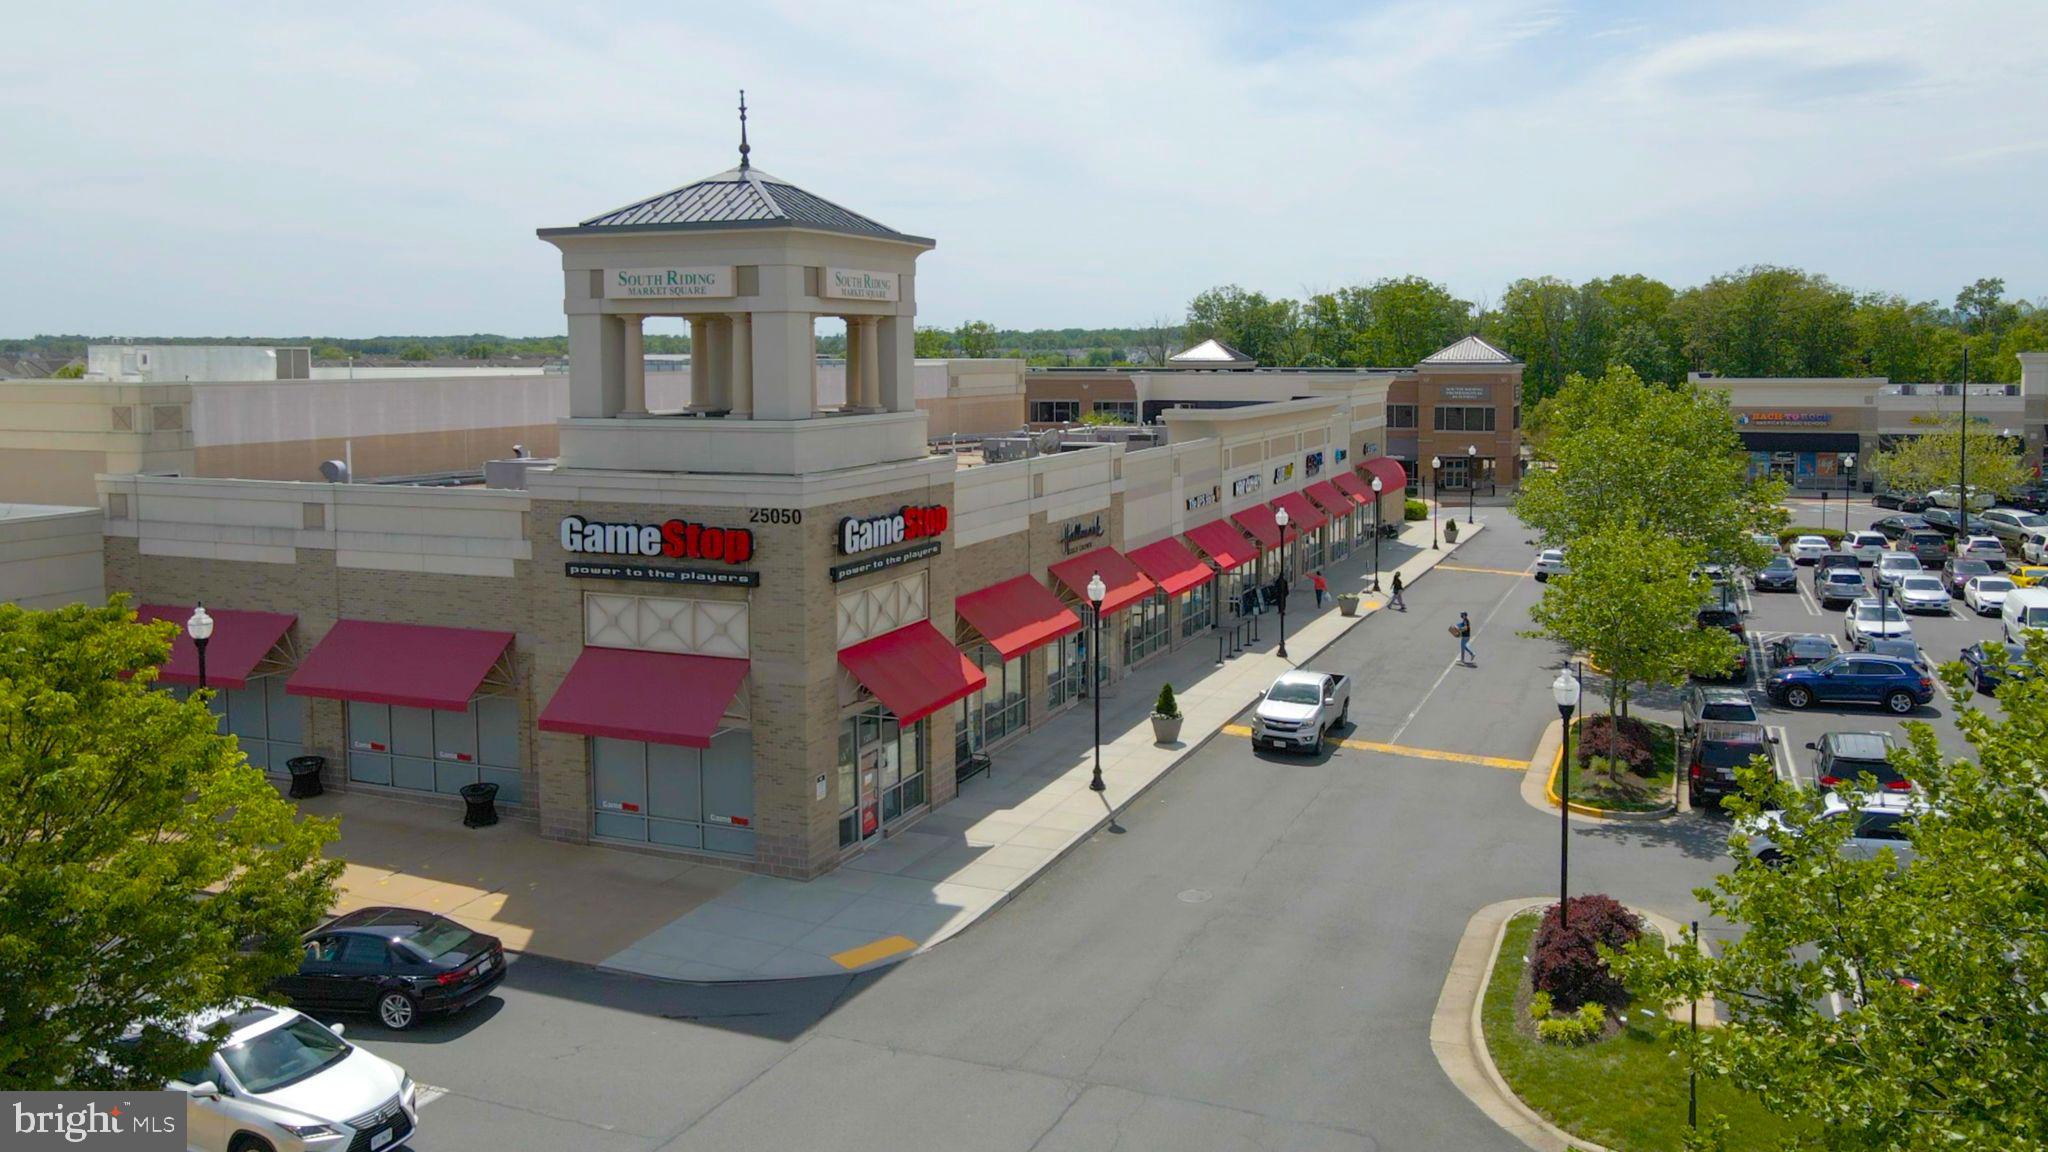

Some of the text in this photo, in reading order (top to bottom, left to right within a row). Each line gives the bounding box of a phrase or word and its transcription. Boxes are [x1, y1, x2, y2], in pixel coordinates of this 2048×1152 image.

[618, 270, 715, 286] SOUTH RIDING
[628, 286, 707, 297] MARKET SQUARE
[750, 508, 802, 525] 25050
[842, 504, 948, 554] GameStop
[560, 516, 753, 564] GameStop
[838, 546, 939, 579] power to the players
[570, 565, 749, 583] power to the players
